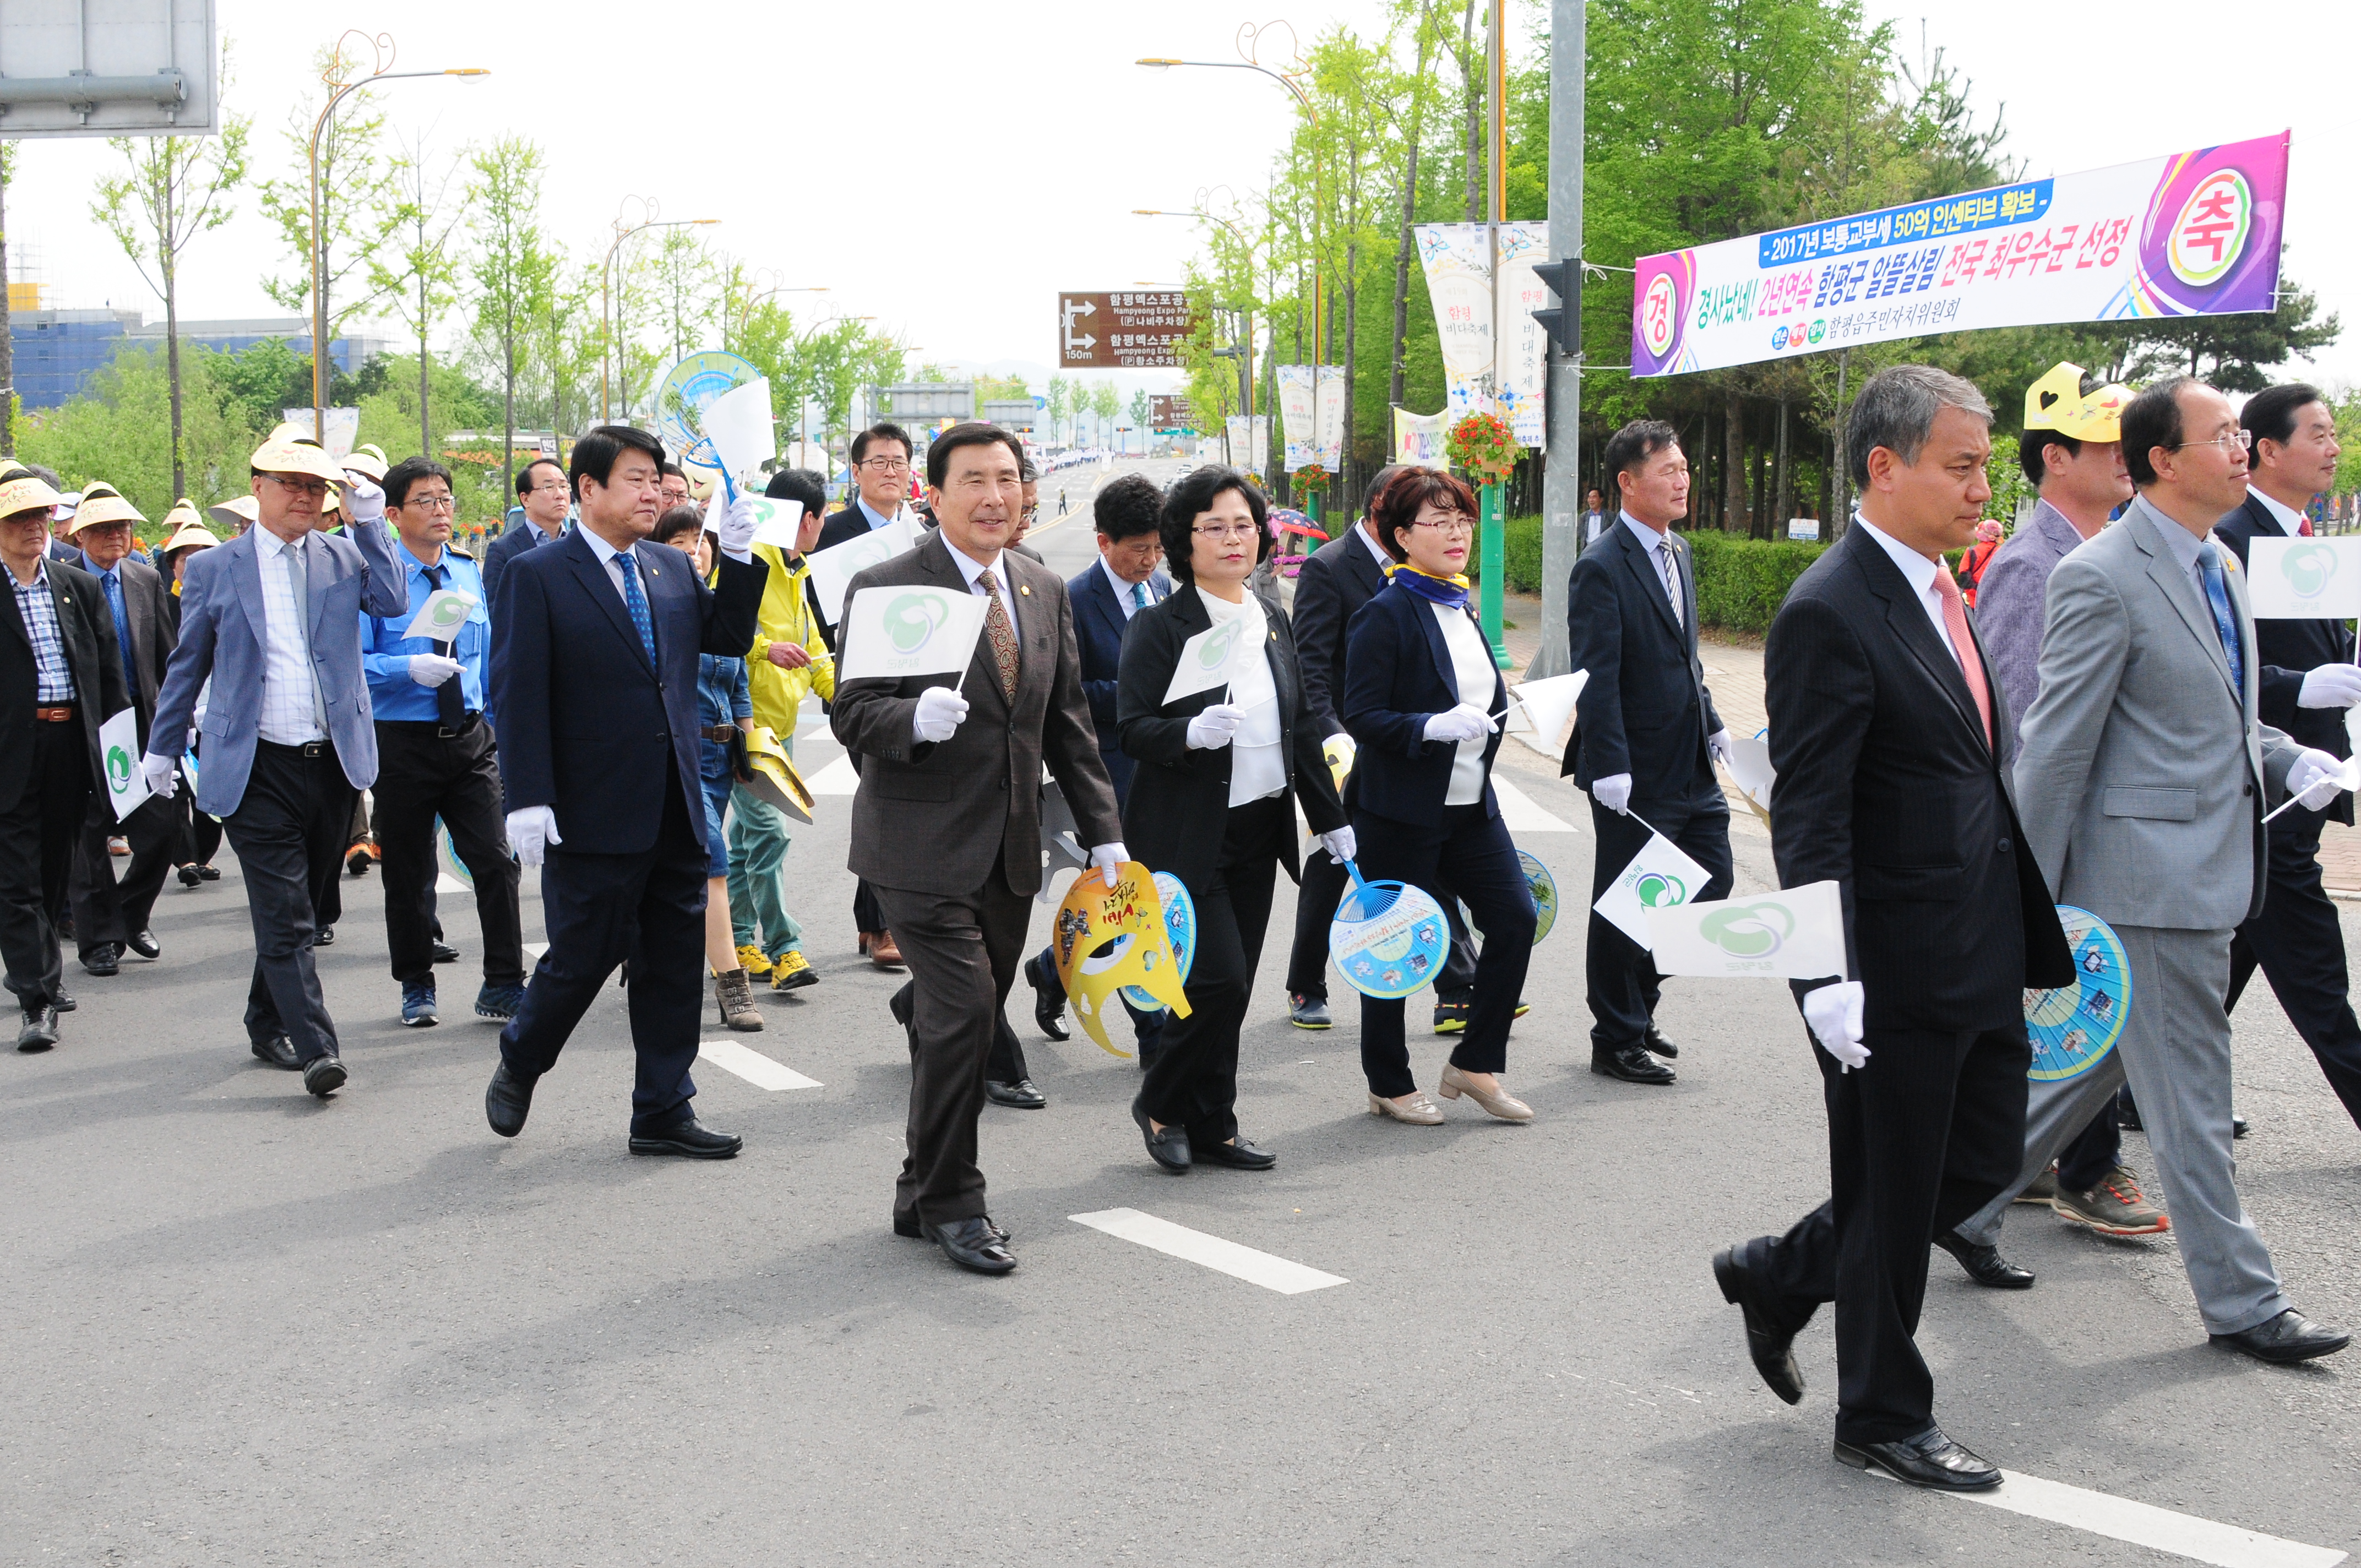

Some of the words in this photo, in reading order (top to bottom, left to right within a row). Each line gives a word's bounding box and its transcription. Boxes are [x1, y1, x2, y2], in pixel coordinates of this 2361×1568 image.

[1771, 228, 1819, 262] 2017년
[1820, 215, 1892, 253] 보통교부세
[1894, 208, 1930, 238] 50억
[1930, 195, 1998, 236] 인센티브
[2000, 188, 2036, 222] 확보
[2183, 189, 2235, 262] 축
[1698, 278, 1759, 330] 경사났네!
[1758, 268, 1813, 317] 2년연속
[1813, 259, 1870, 309] 함평군
[1864, 245, 1946, 300] 알뜰살림
[1940, 238, 1989, 287] 전국
[1982, 224, 2080, 281] 최우수군
[2075, 214, 2134, 270] 선정
[1521, 290, 1542, 303] 함평
[1113, 307, 1155, 315] Hampyeong
[1156, 307, 1176, 315] Expo
[1448, 306, 1471, 320] 함평
[1649, 290, 1668, 343] 경
[1829, 298, 1961, 340] 함평읍주민자치위원회
[1065, 350, 1093, 360] 150m
[1114, 347, 1156, 356] Hampyeong
